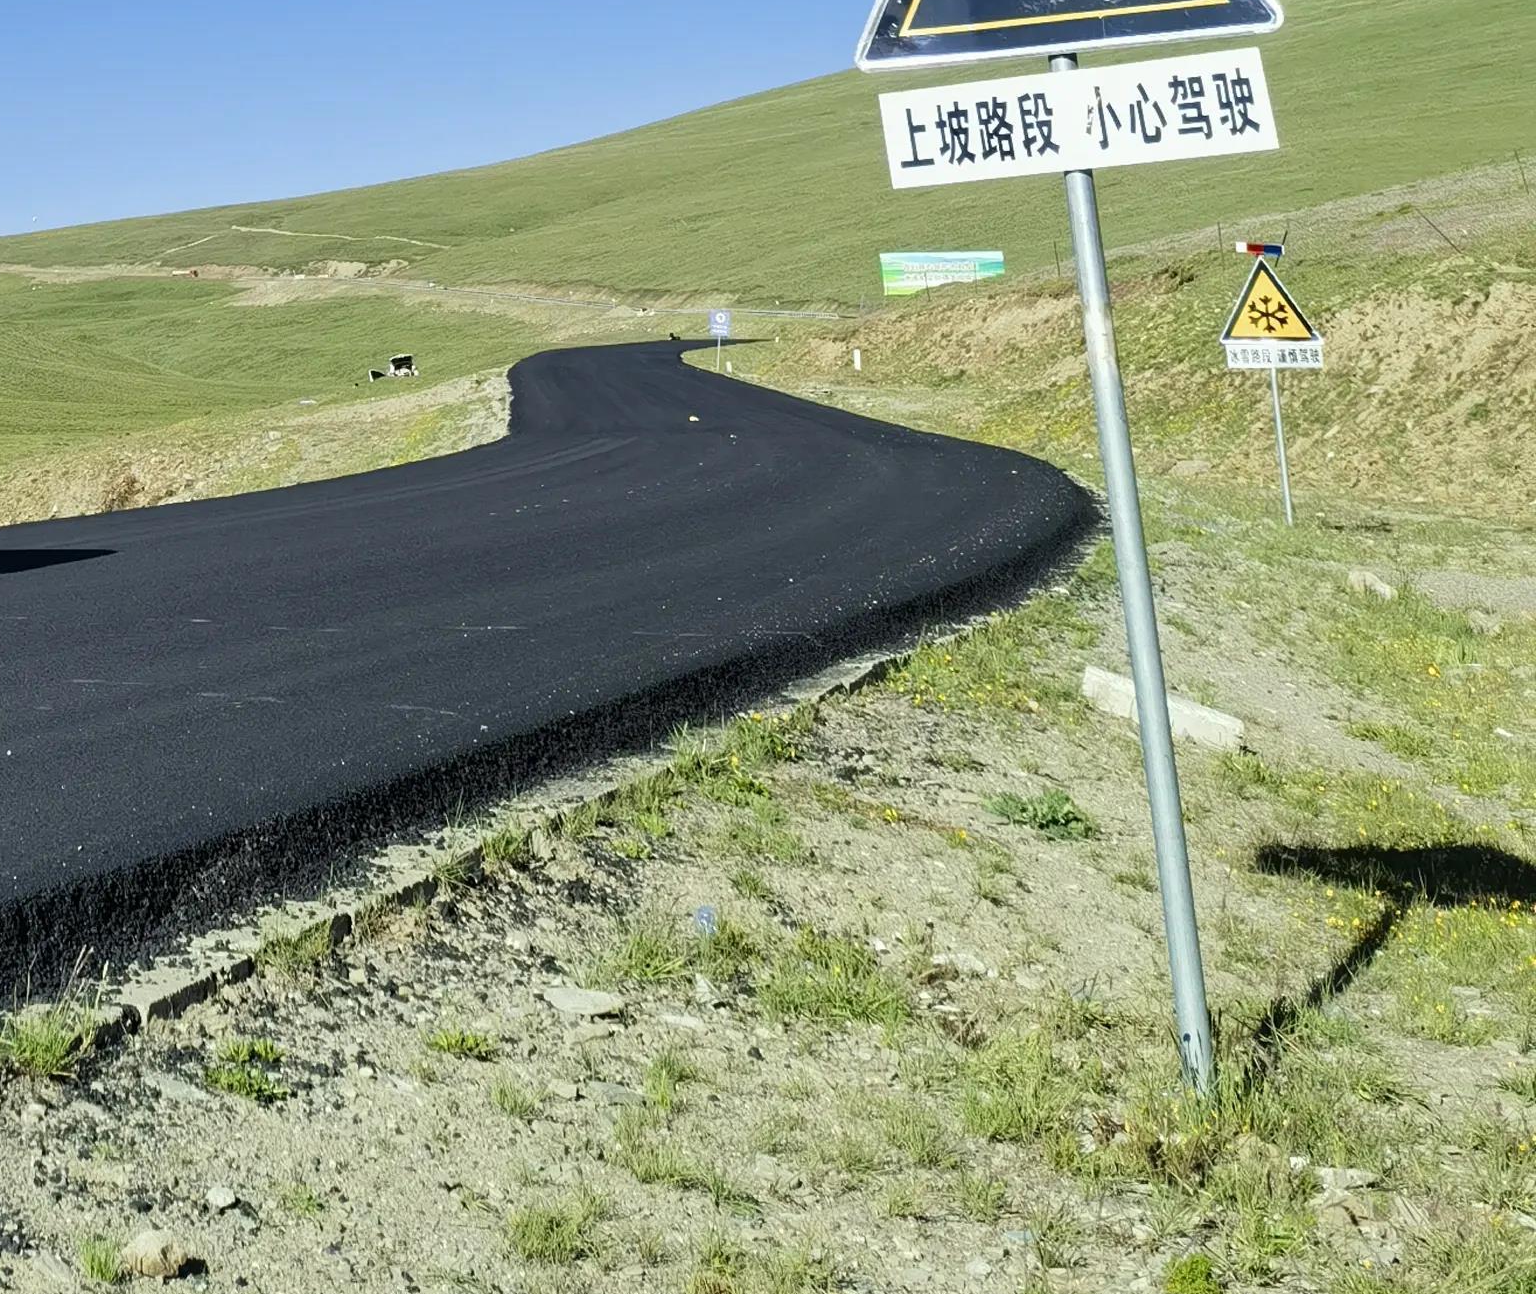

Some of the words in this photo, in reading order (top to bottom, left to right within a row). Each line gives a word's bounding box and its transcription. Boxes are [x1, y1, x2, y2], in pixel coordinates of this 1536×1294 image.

[900, 91, 1061, 169] 上坡路段
[1085, 67, 1261, 150] 小心驾驶
